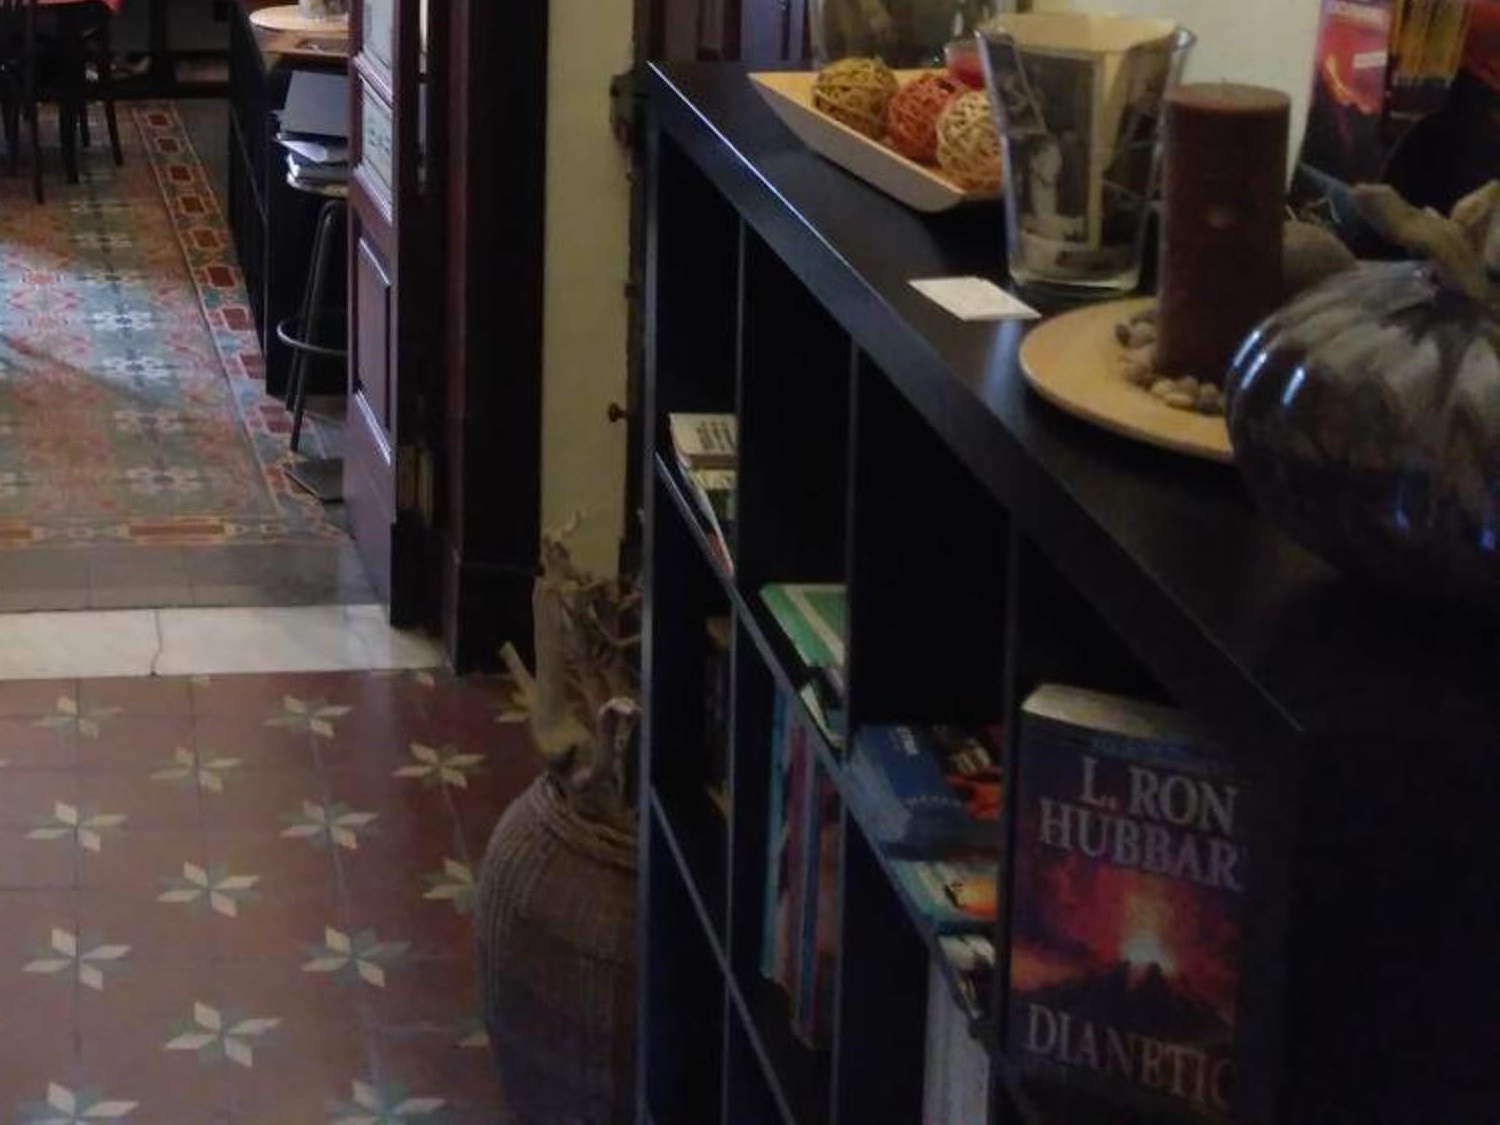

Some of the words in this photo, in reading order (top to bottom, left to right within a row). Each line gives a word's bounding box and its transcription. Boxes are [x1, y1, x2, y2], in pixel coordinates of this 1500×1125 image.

[1077, 756, 1117, 811] L.
[1127, 764, 1240, 835] RON
[1038, 797, 1246, 893] HUBBAR
